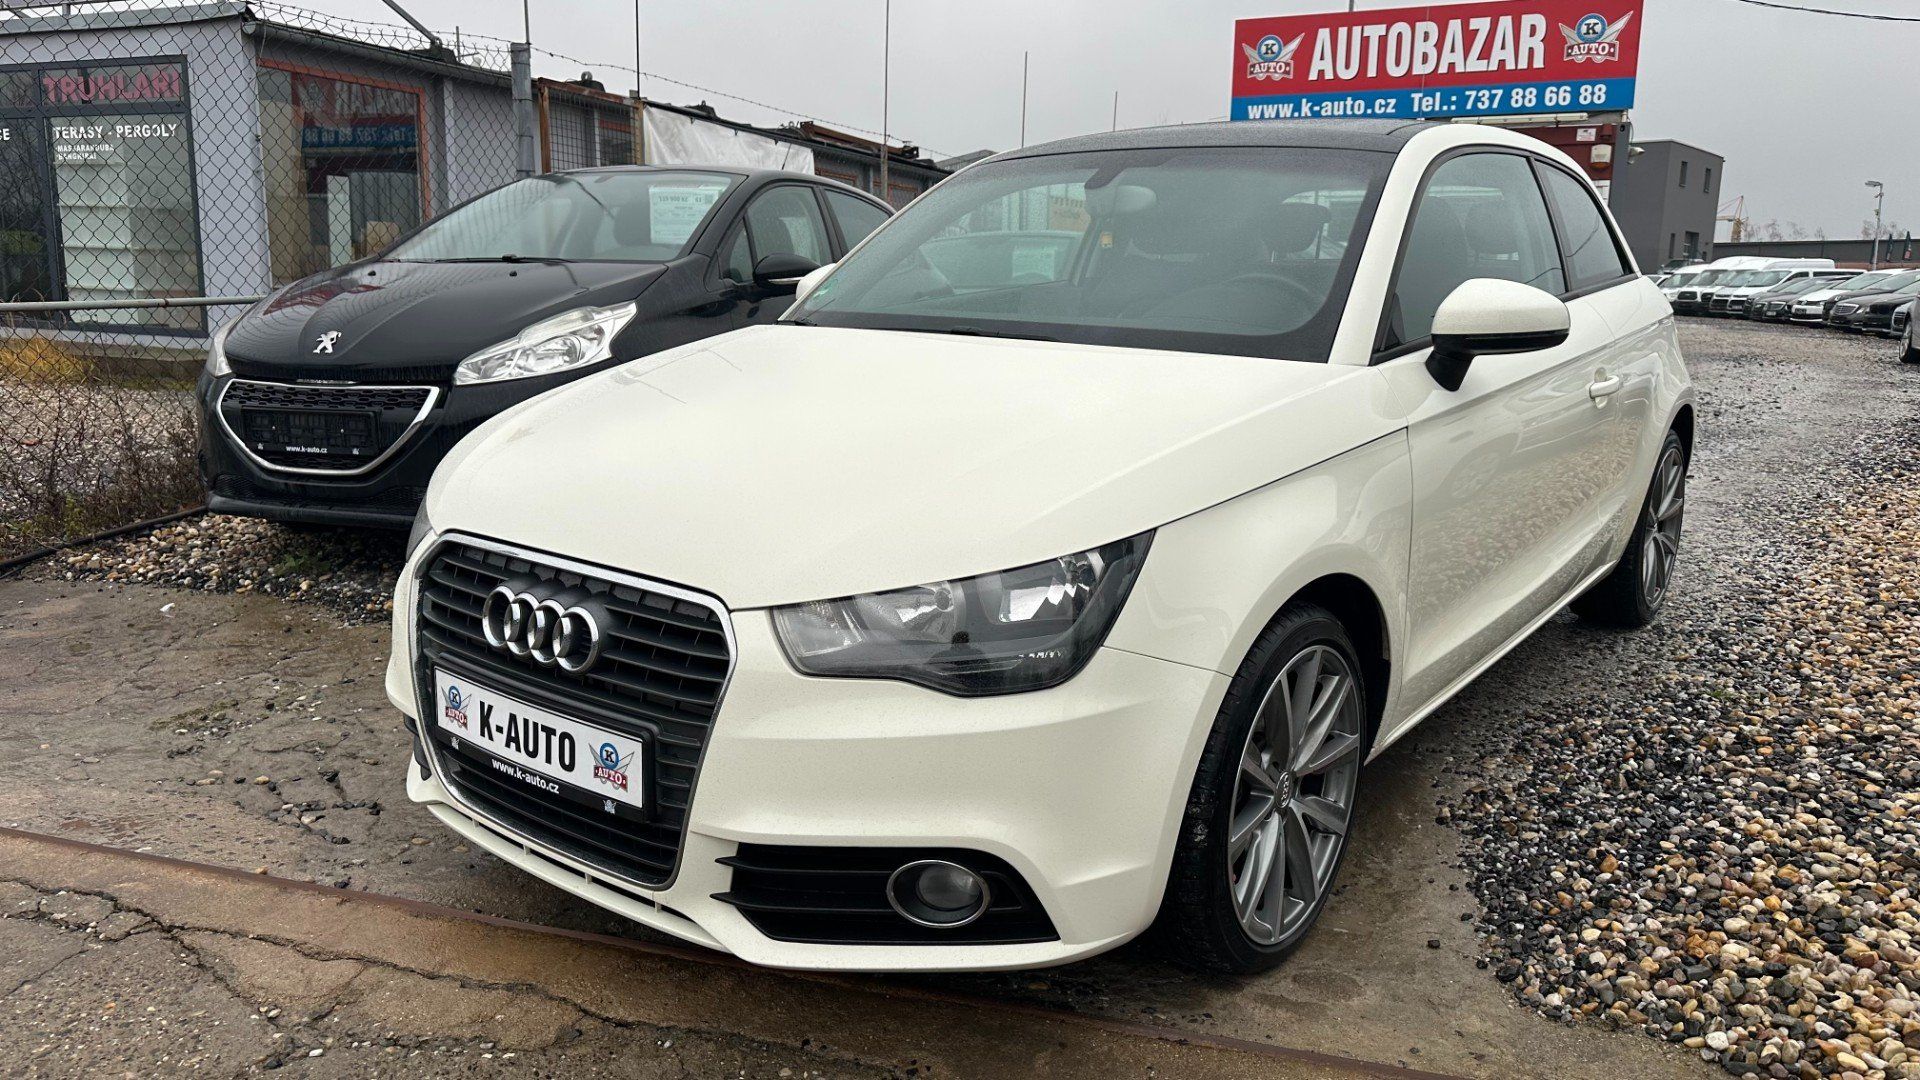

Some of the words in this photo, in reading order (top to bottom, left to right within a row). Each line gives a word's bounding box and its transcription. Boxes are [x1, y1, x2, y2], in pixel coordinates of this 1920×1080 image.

[1583, 22, 1599, 36] K
[1263, 43, 1277, 56] K
[1308, 14, 1547, 81] AUTOBAZAR
[1571, 43, 1609, 55] AUTO
[1252, 61, 1287, 74] AUTO
[1247, 97, 1397, 119] www.k-auto.cz
[1411, 92, 1457, 112] Tel.:
[1465, 89, 1503, 110] 737
[1510, 87, 1537, 108] 88
[1544, 85, 1571, 106] 66
[1579, 84, 1607, 105] 88
[53, 126, 103, 139] TERASY
[115, 124, 177, 138] PERGOLY
[450, 691, 460, 705] K
[447, 707, 465, 725] AUTO
[479, 700, 576, 773] K-AUTO
[604, 749, 615, 764] K
[491, 758, 560, 794] www.k-auto.cz
[596, 767, 623, 786] AUTO
